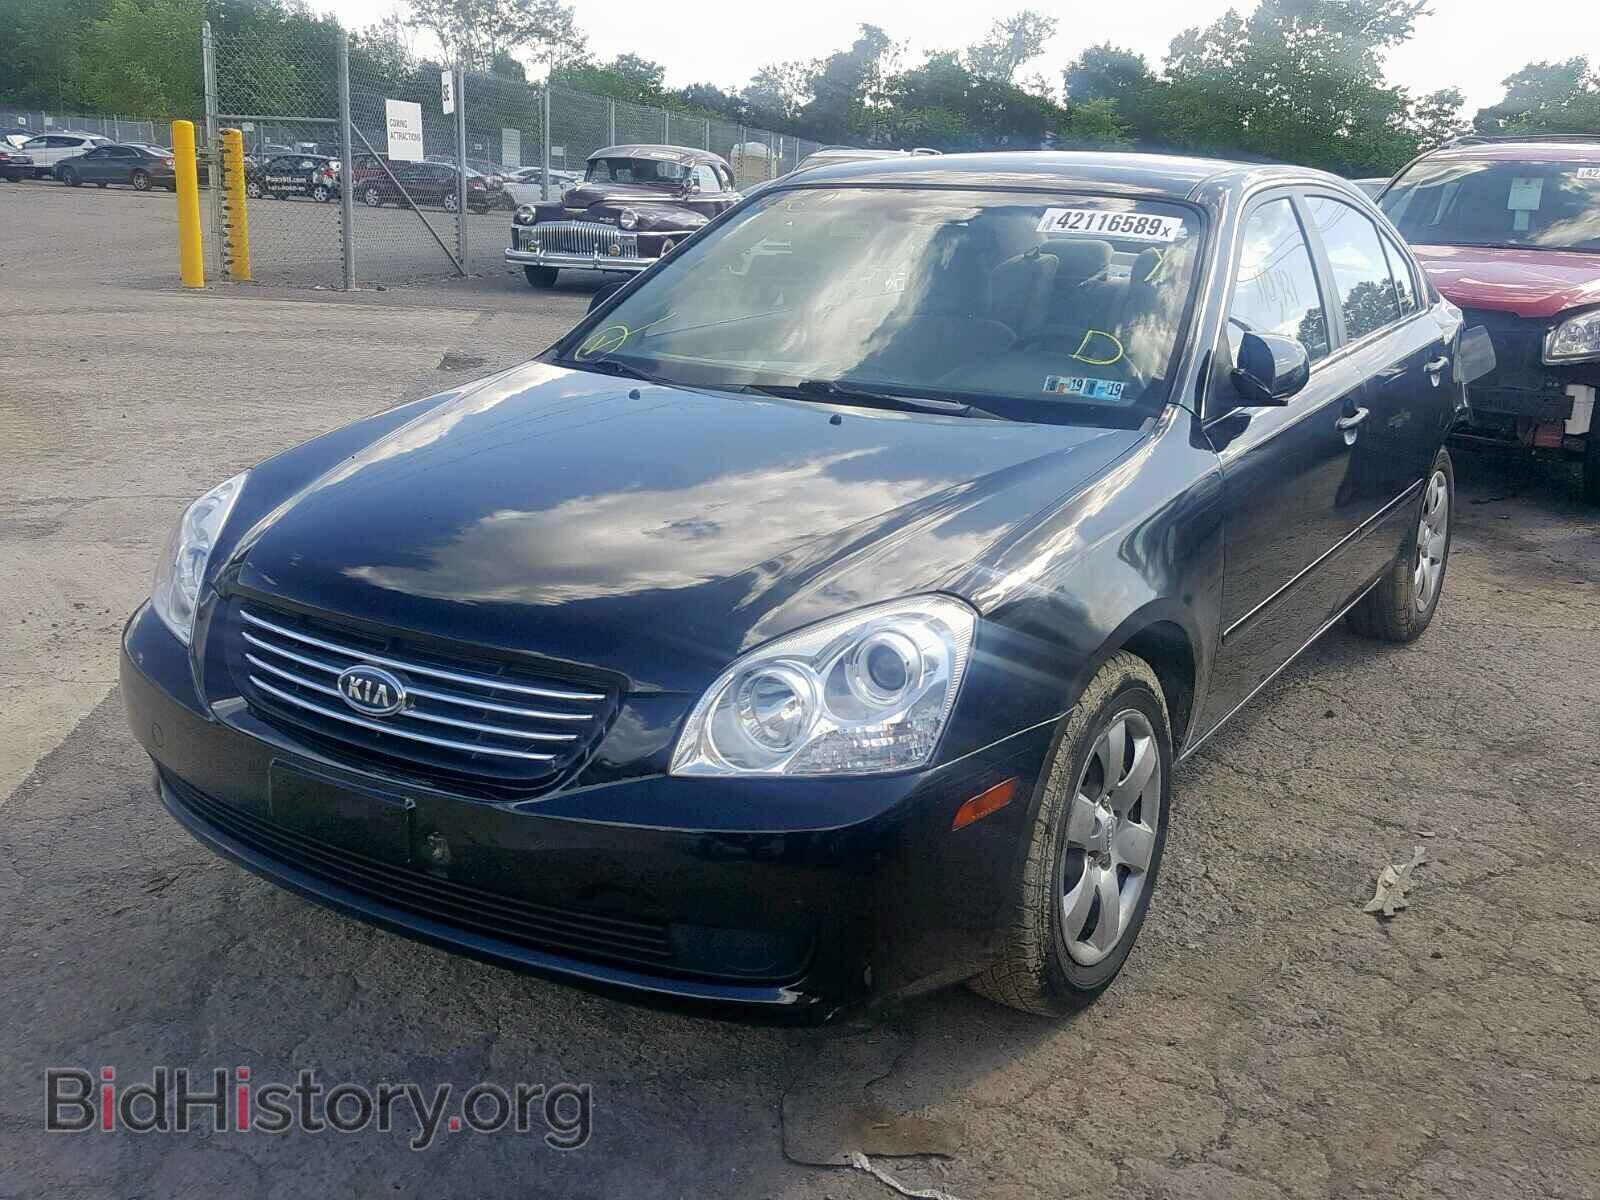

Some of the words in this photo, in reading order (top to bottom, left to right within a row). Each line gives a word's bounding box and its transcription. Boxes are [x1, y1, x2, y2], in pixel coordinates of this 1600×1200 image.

[1071, 379, 1083, 391] 19
[1108, 383, 1122, 396] 19
[348, 675, 389, 707] KIA
